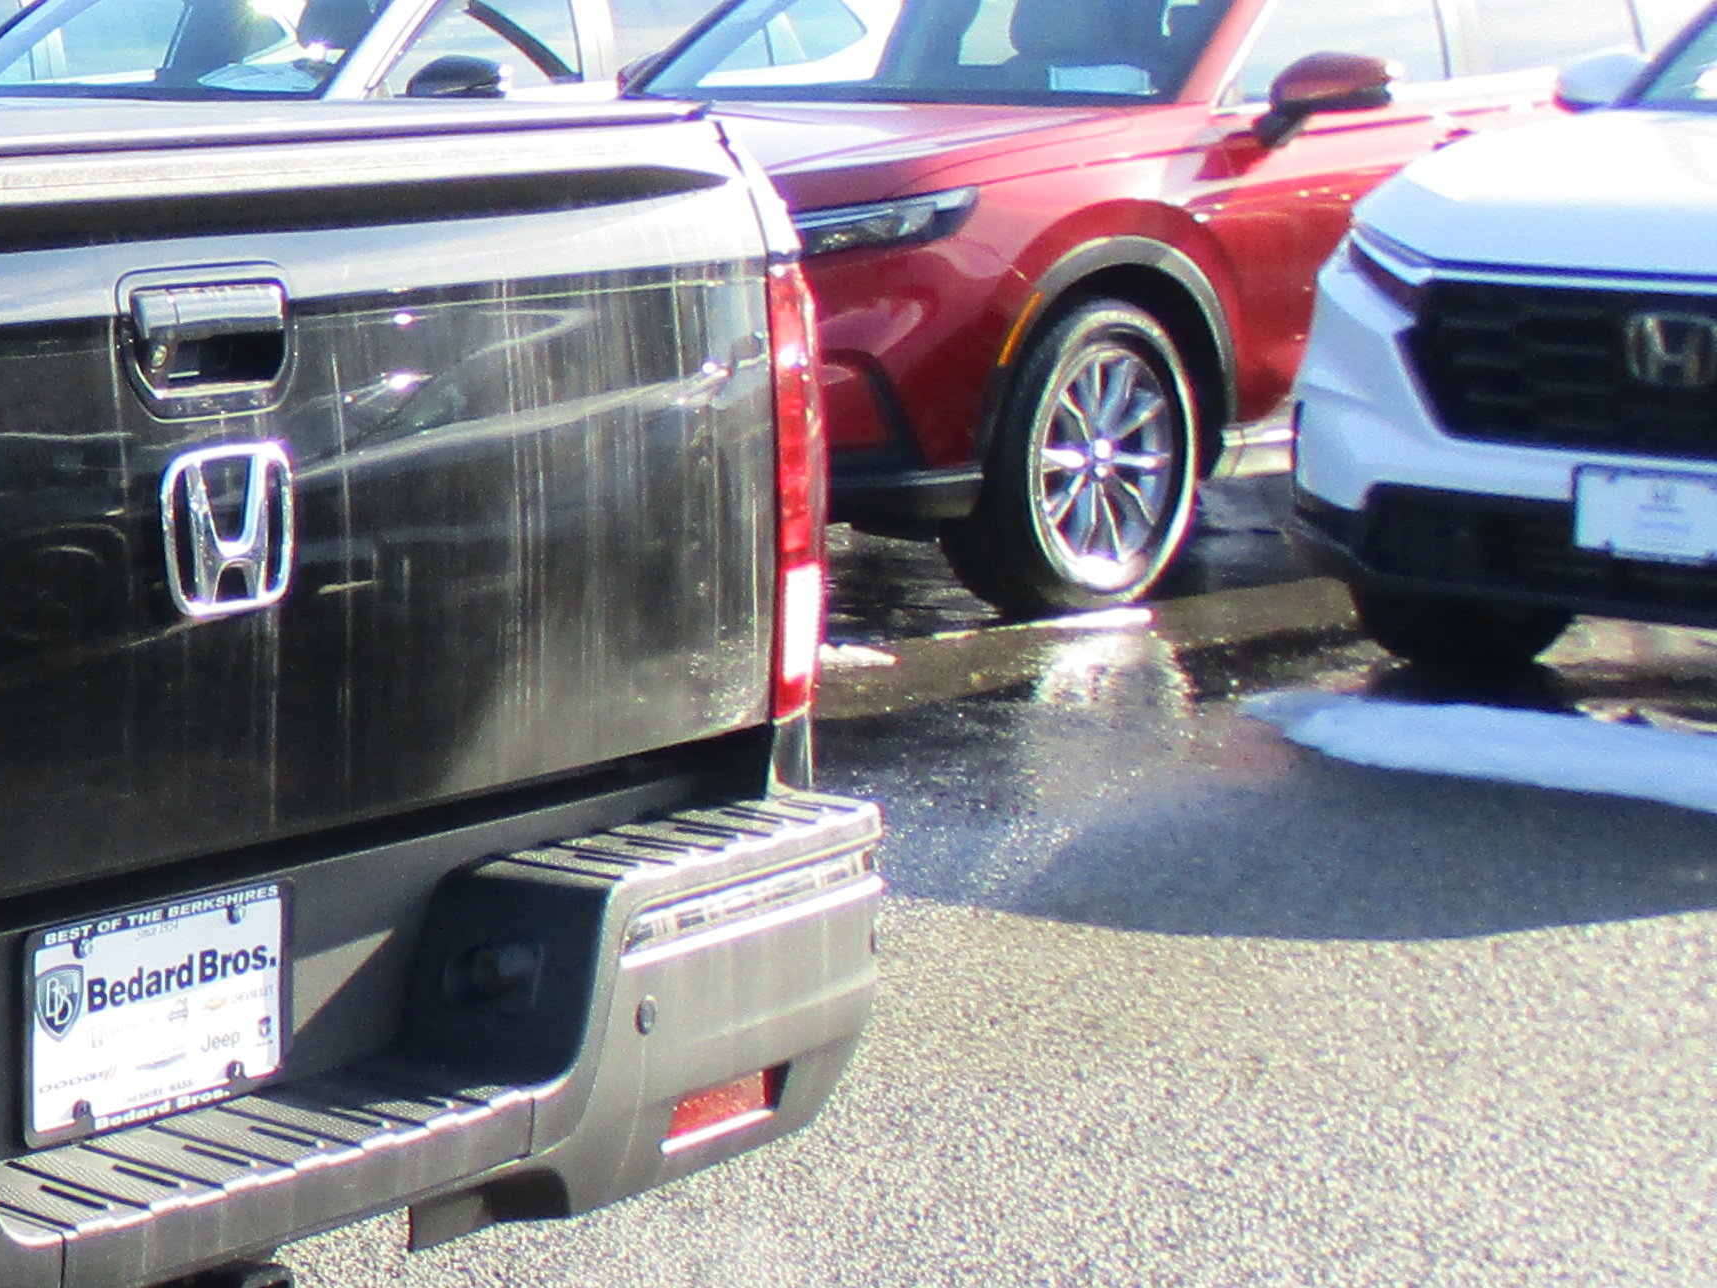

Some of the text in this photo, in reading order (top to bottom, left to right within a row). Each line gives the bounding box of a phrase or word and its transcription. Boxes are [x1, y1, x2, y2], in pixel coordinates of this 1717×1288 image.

[44, 924, 93, 946] BEST
[97, 918, 123, 933] OF
[127, 909, 164, 927] THE
[168, 885, 279, 918] BERKSHIRES
[200, 1031, 241, 1052] Jeep
